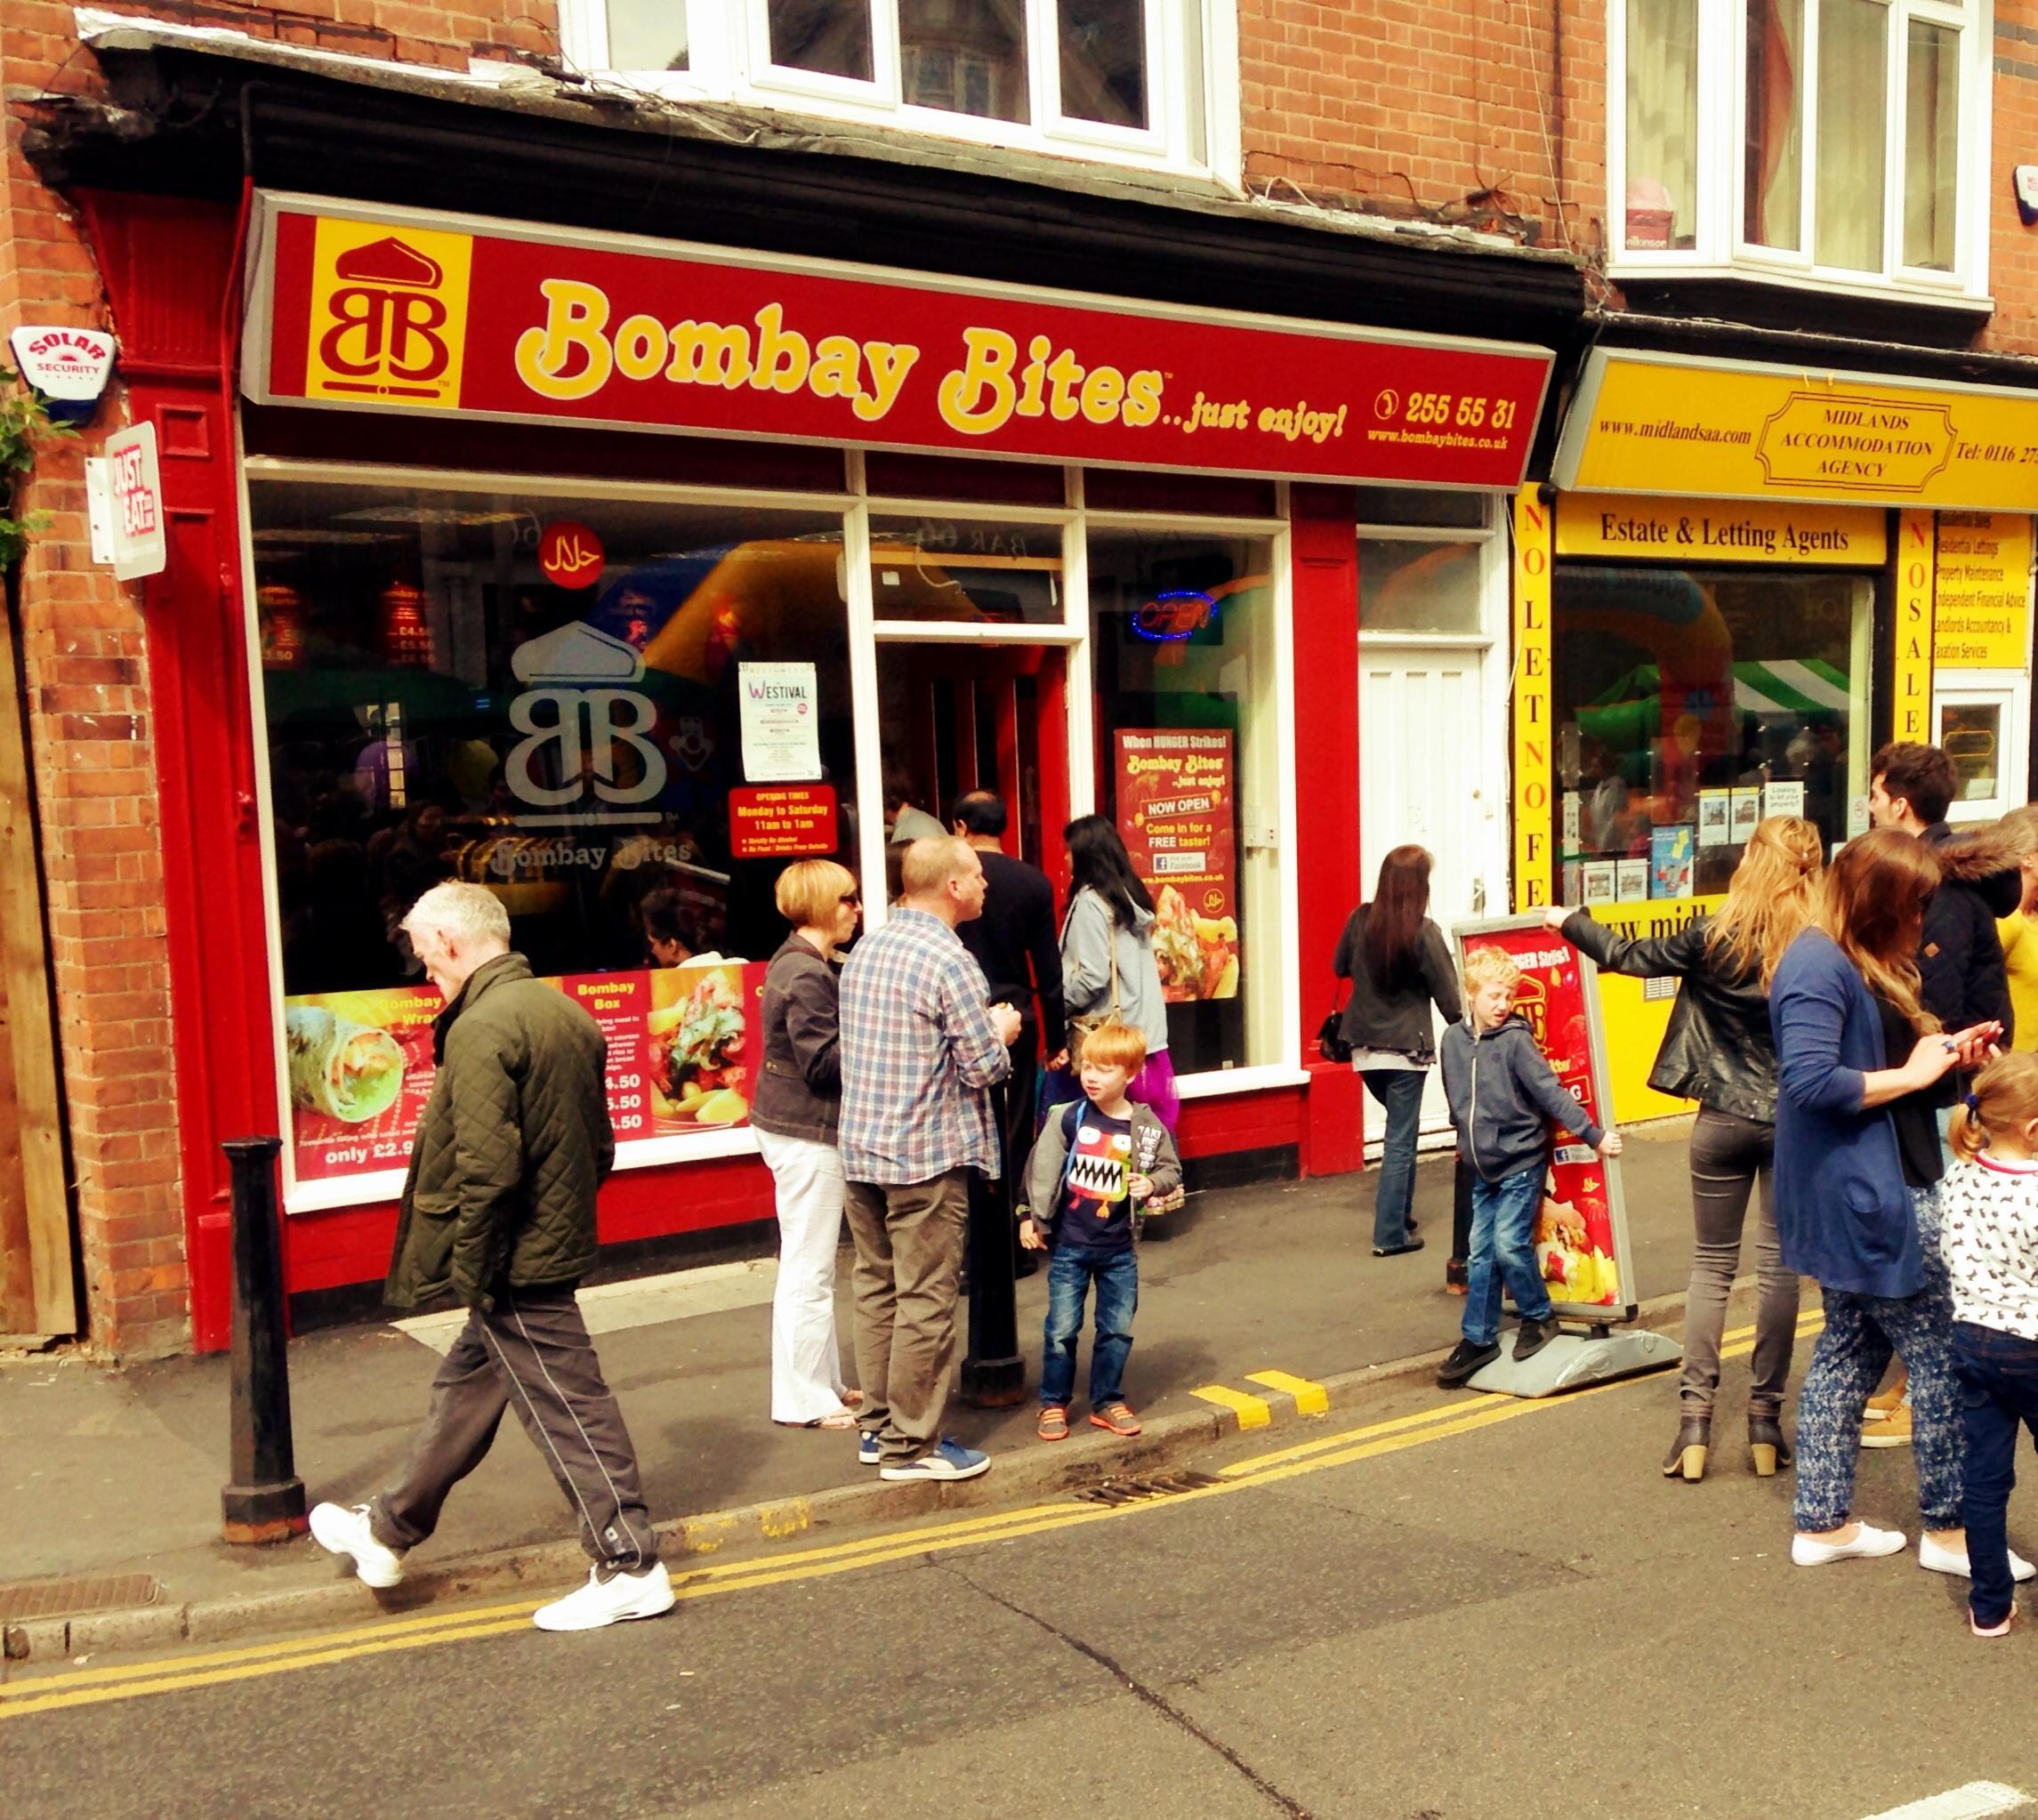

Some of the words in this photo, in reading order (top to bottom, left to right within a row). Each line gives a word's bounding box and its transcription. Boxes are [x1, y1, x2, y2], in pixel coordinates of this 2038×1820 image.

[28, 333, 107, 359] SOLAR
[515, 278, 920, 421] Bombay
[938, 327, 1164, 434] Bites
[36, 363, 100, 375] SECURITY
[1406, 392, 1452, 423] 255
[1455, 397, 1486, 426] 55
[1491, 399, 1516, 429] 31
[1823, 409, 1910, 431] MIDLANDS
[1258, 401, 1348, 443] enjoy!
[1367, 429, 1508, 449] www.bombaybites.co.uk
[1599, 420, 1752, 445] www.midlandsaa.com
[1780, 432, 1935, 456] ACCOMMODATION
[1956, 442, 1980, 460] Tel:
[1985, 444, 2016, 462] 0116
[114, 447, 142, 495] JUST
[1816, 460, 1888, 478] AGENCY
[123, 491, 145, 534] EAT
[1600, 513, 1669, 544] Estate
[1676, 517, 1695, 544] &
[1703, 519, 1776, 555] Letting
[1783, 524, 1849, 556] Agents
[1139, 601, 1208, 629] OPEN
[748, 679, 808, 700] WESTIVAL
[1123, 736, 1153, 748] When
[1153, 736, 1189, 748] HUNGER
[1190, 735, 1227, 748] Strikes!
[1127, 754, 1182, 774] Bombay
[1185, 754, 1224, 774] Bites
[737, 806, 774, 817] Monday
[776, 806, 786, 816] to
[788, 804, 828, 816] Saturday
[1148, 801, 1176, 815] NOW
[1178, 798, 1210, 812] OPEN
[755, 820, 780, 830] 11am
[782, 820, 792, 829] to
[794, 819, 814, 828] 1am
[1146, 824, 1175, 833] Come
[1177, 823, 1187, 833] in
[1189, 823, 1204, 833] for
[1206, 825, 1212, 833] a
[1148, 837, 1176, 847] FREE
[1179, 836, 1210, 846] taster!
[490, 842, 608, 876] Bombay
[1525, 833, 1545, 908] FE
[577, 982, 635, 995] Bombay
[380, 996, 441, 1010] Bombay
[594, 999, 620, 1010] Box
[606, 1075, 640, 1090] 4.50
[607, 1095, 641, 1111] 5.50
[611, 1115, 642, 1130] .50
[326, 1147, 367, 1164] only
[373, 1141, 414, 1158] £2.9
